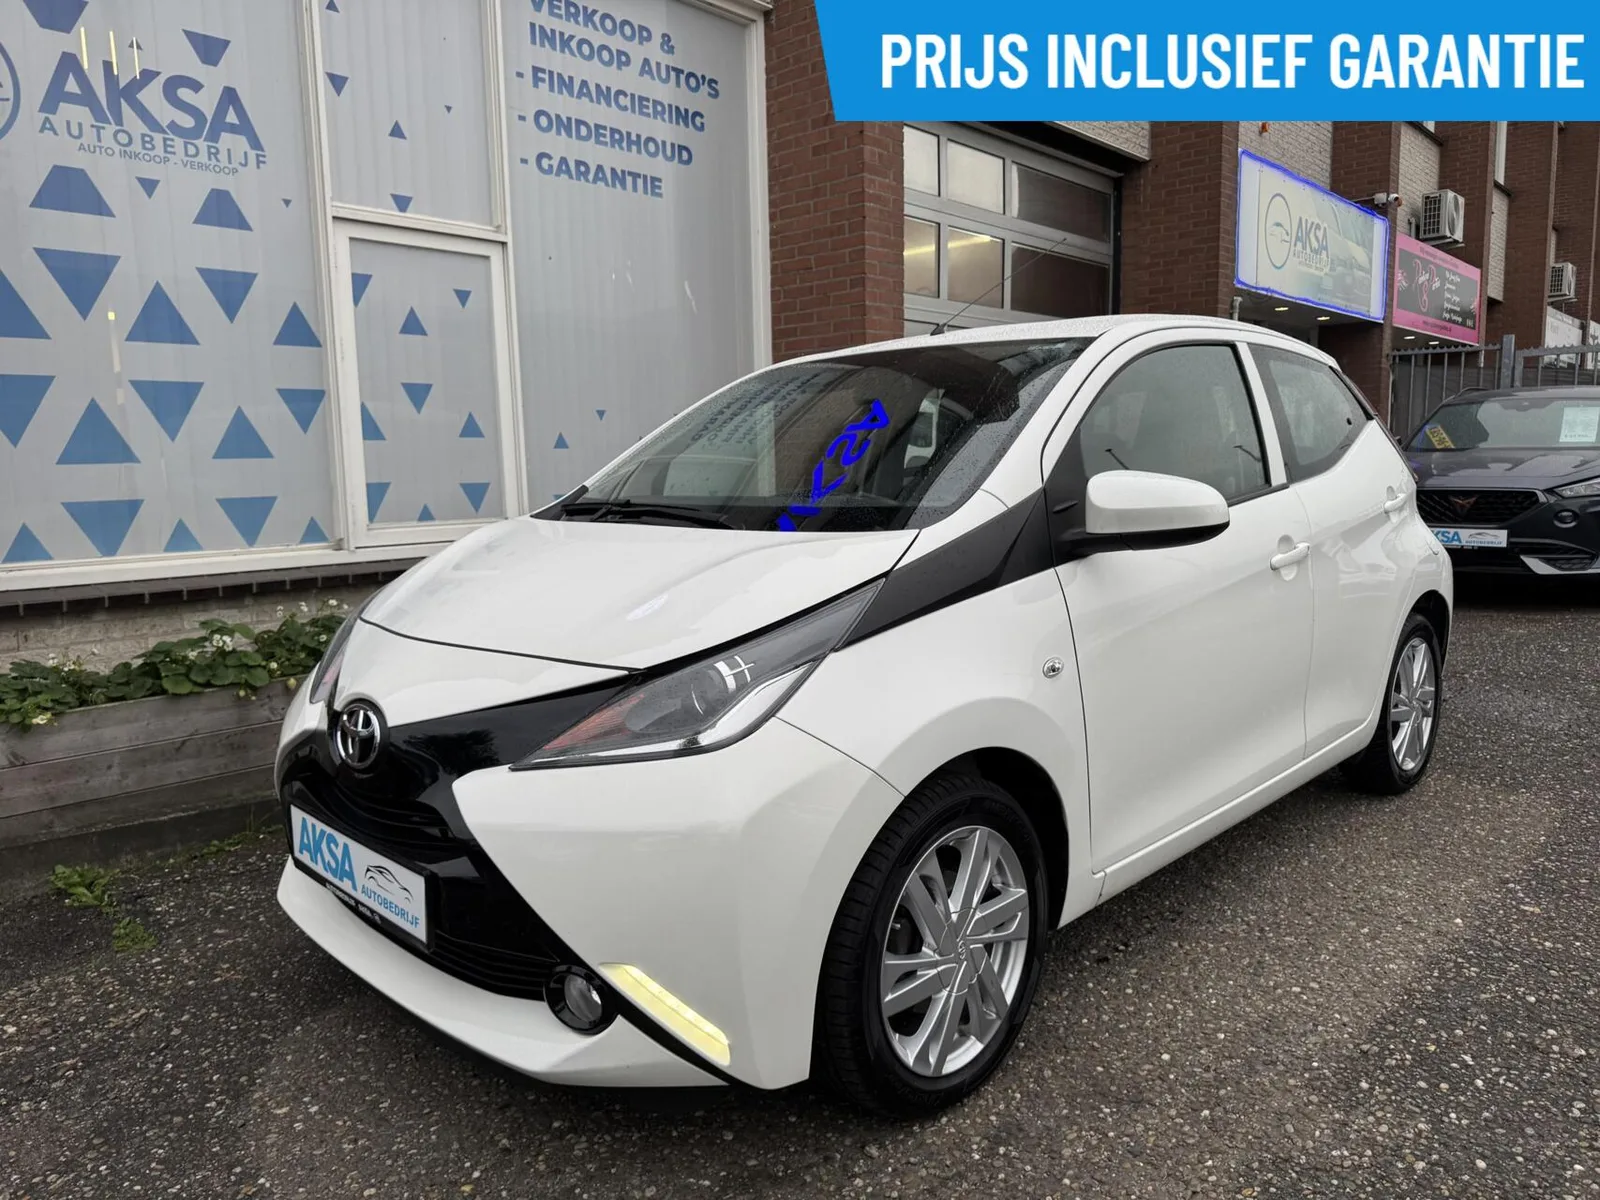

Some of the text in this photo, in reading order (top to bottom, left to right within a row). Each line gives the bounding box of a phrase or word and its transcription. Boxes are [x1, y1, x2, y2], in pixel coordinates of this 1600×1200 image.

[529, 0, 675, 56] VERKOOP &
[529, 22, 720, 99] INKOOP AUTO'S
[38, 51, 265, 152] AKSA
[531, 65, 705, 132] FINANCIERING
[38, 116, 267, 169] AUTOBEDRIJF
[78, 143, 116, 158] AUTO
[119, 149, 170, 165] INKOOP
[181, 159, 239, 176] VERKOOP
[533, 109, 693, 166] ONDERHOUD
[535, 151, 663, 198] GARANTIE
[1294, 216, 1329, 259] AKSA
[1431, 530, 1462, 544] KSA
[299, 816, 358, 892] AKSA
[361, 884, 421, 929] AUTOBEDRIJF
